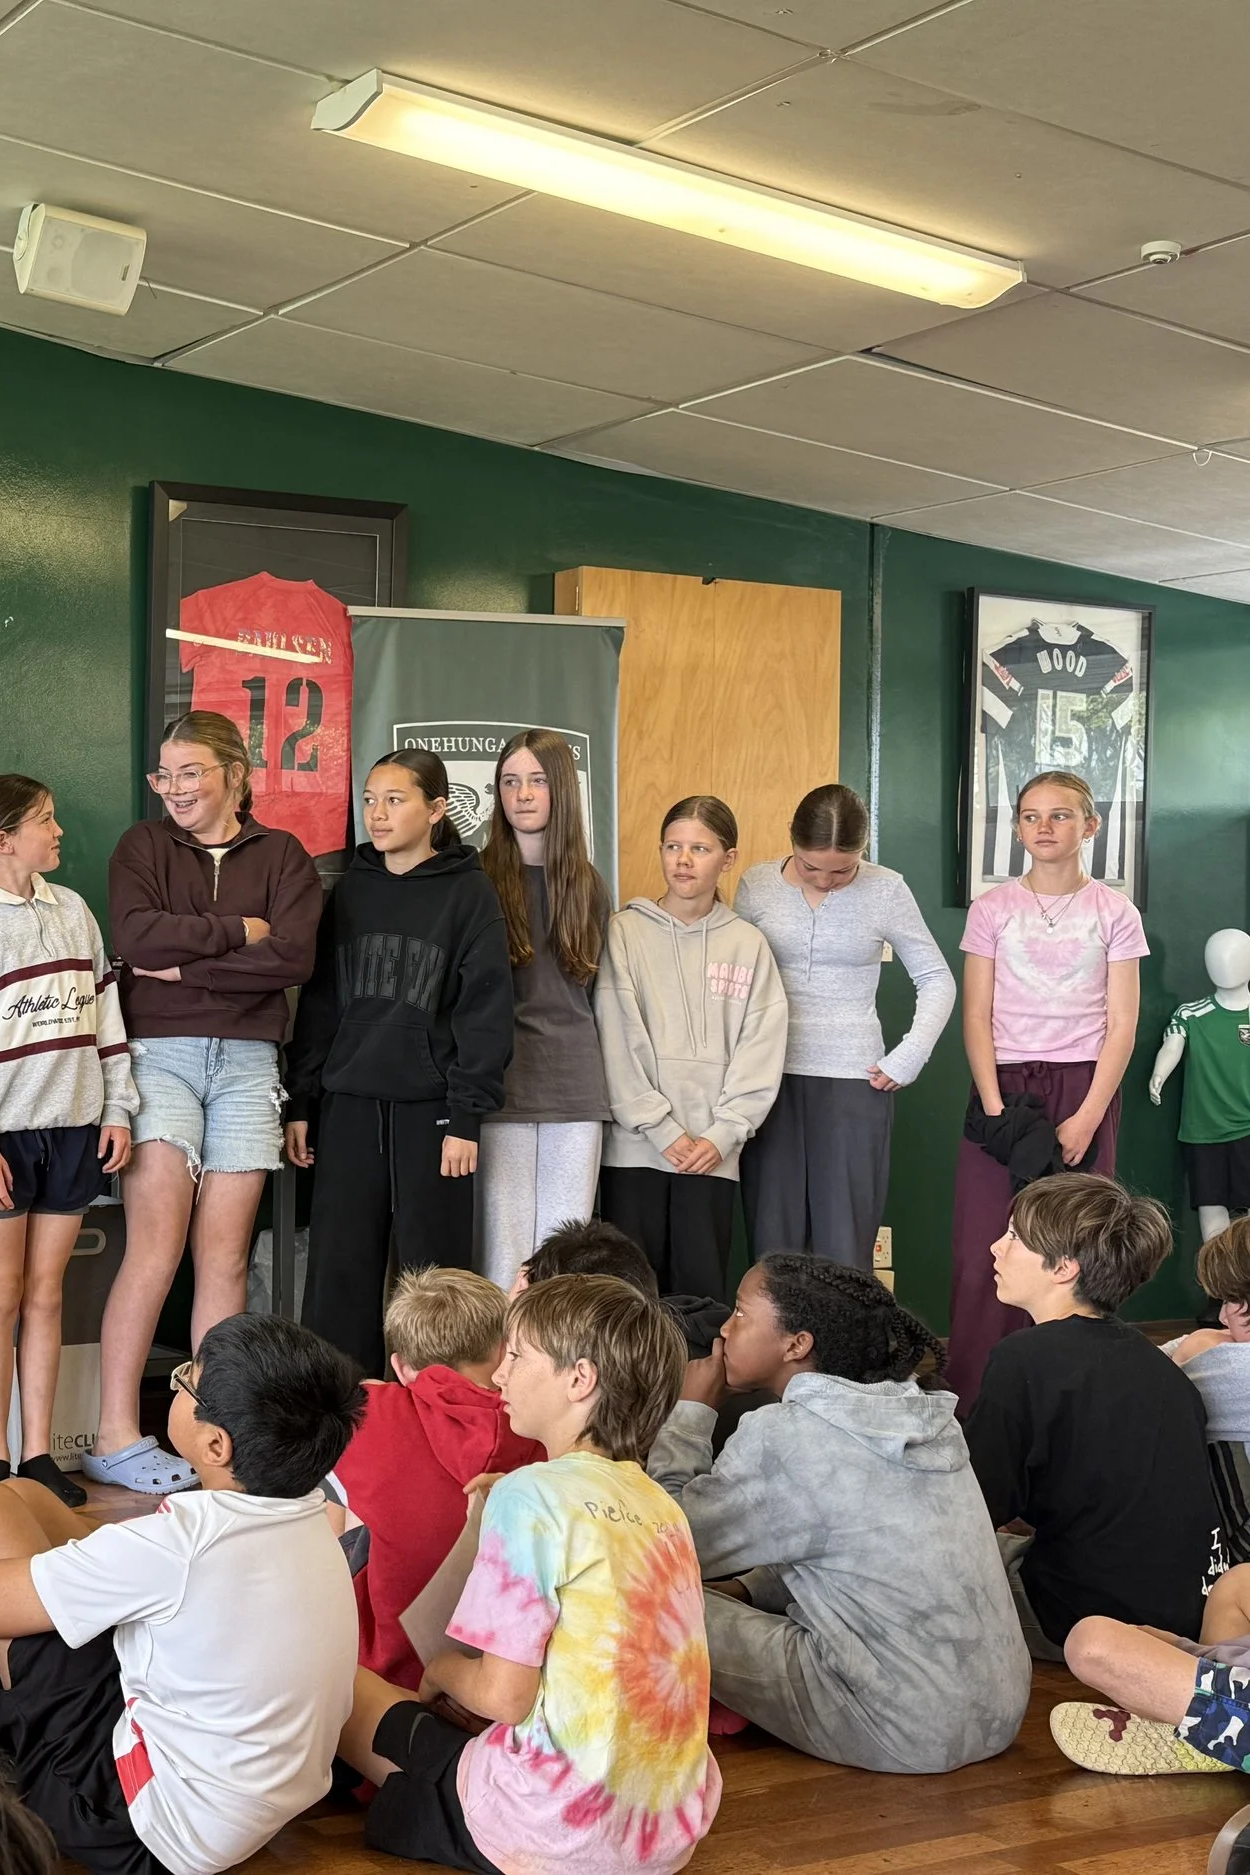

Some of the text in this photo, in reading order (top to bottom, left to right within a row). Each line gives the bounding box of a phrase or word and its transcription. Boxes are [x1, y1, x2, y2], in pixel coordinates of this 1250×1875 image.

[1036, 647, 1087, 677] WOOD
[241, 675, 324, 772] 12
[1034, 688, 1089, 767] 15
[404, 737, 507, 753] ONEHUNGA
[1, 994, 60, 1020] Athletic
[52, 1433, 95, 1450] iteCL
